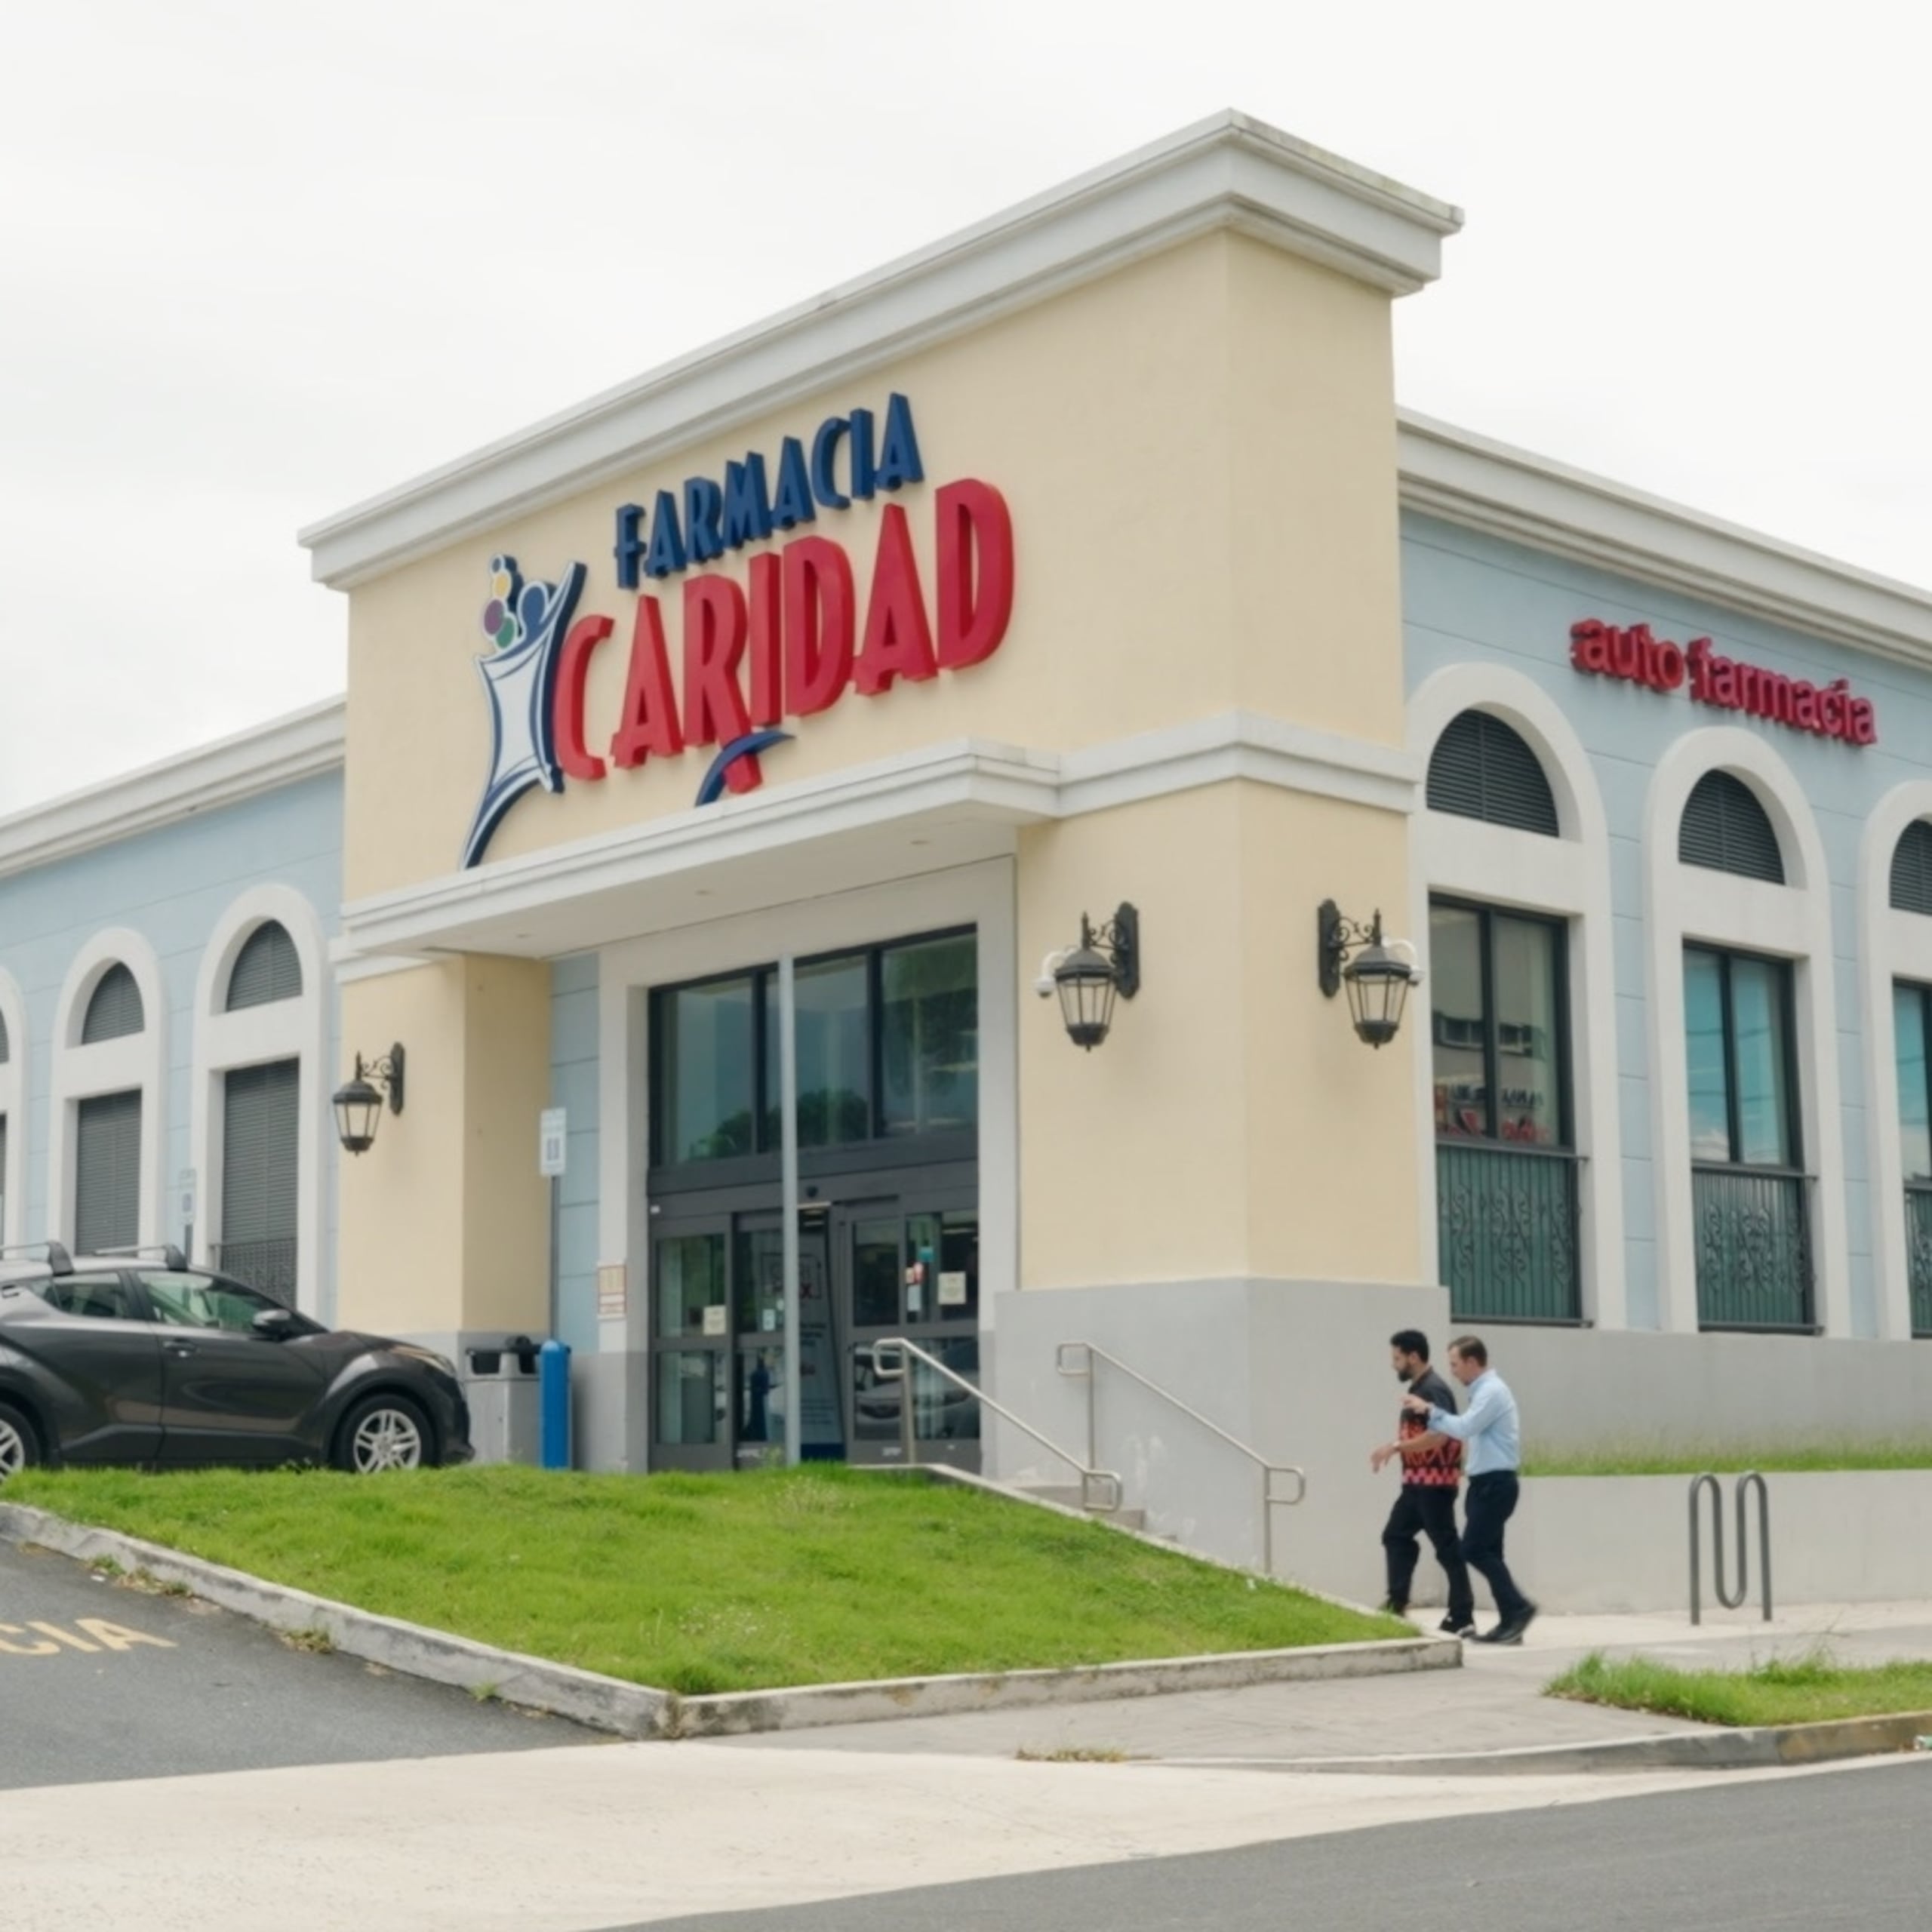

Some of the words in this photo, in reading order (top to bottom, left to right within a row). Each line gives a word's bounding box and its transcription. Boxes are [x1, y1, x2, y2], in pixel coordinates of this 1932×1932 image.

[614, 392, 924, 589] FARMACIA
[555, 478, 1015, 795] CARIDAD
[1570, 618, 1685, 694] auto
